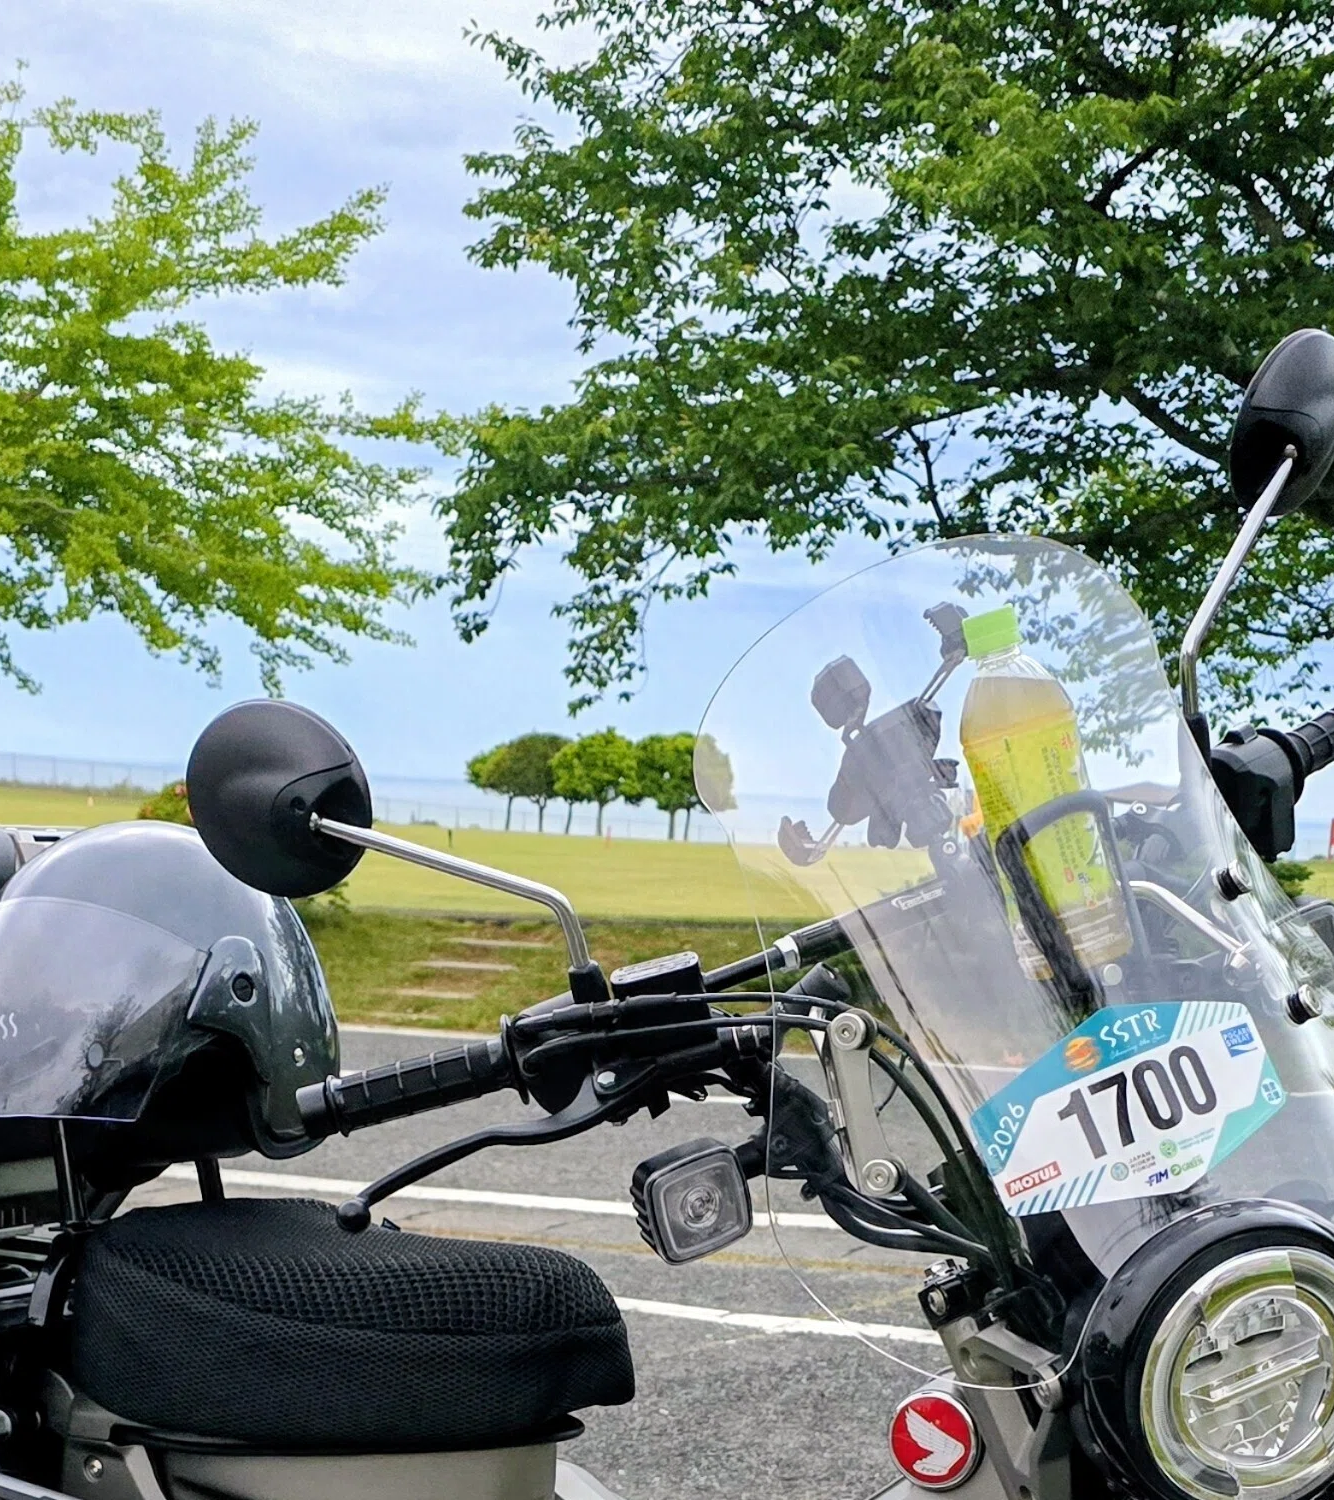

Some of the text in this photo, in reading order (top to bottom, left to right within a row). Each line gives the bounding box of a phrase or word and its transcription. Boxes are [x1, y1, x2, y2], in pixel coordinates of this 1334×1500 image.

[1099, 1008, 1161, 1047] SSTR
[1226, 1033, 1251, 1047] SWEAT
[1057, 1045, 1217, 1160] 1700
[987, 1103, 1025, 1161] 2026
[1009, 1165, 1059, 1195] MOTUL
[1146, 1168, 1169, 1186] FIM
